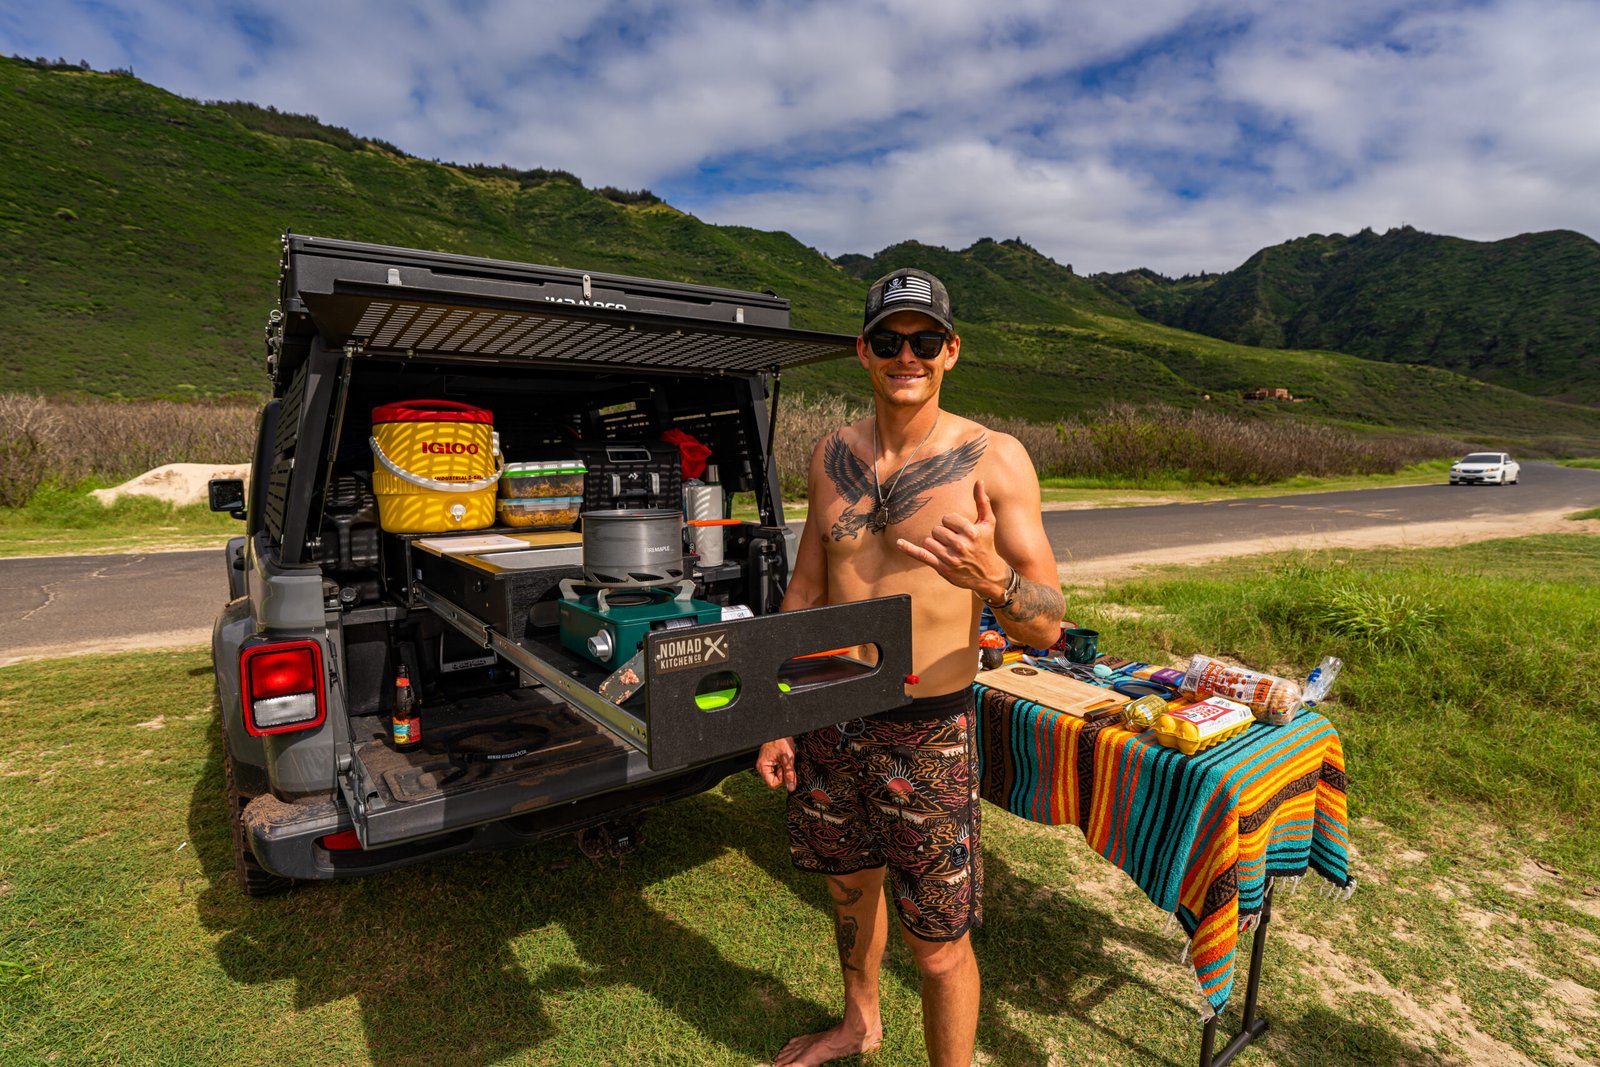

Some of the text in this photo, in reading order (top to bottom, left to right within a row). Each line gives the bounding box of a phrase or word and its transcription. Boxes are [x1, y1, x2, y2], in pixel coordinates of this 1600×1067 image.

[422, 441, 479, 454] IGLOO
[660, 638, 702, 659] NOMAD
[660, 653, 702, 670] KITCHEN CO
